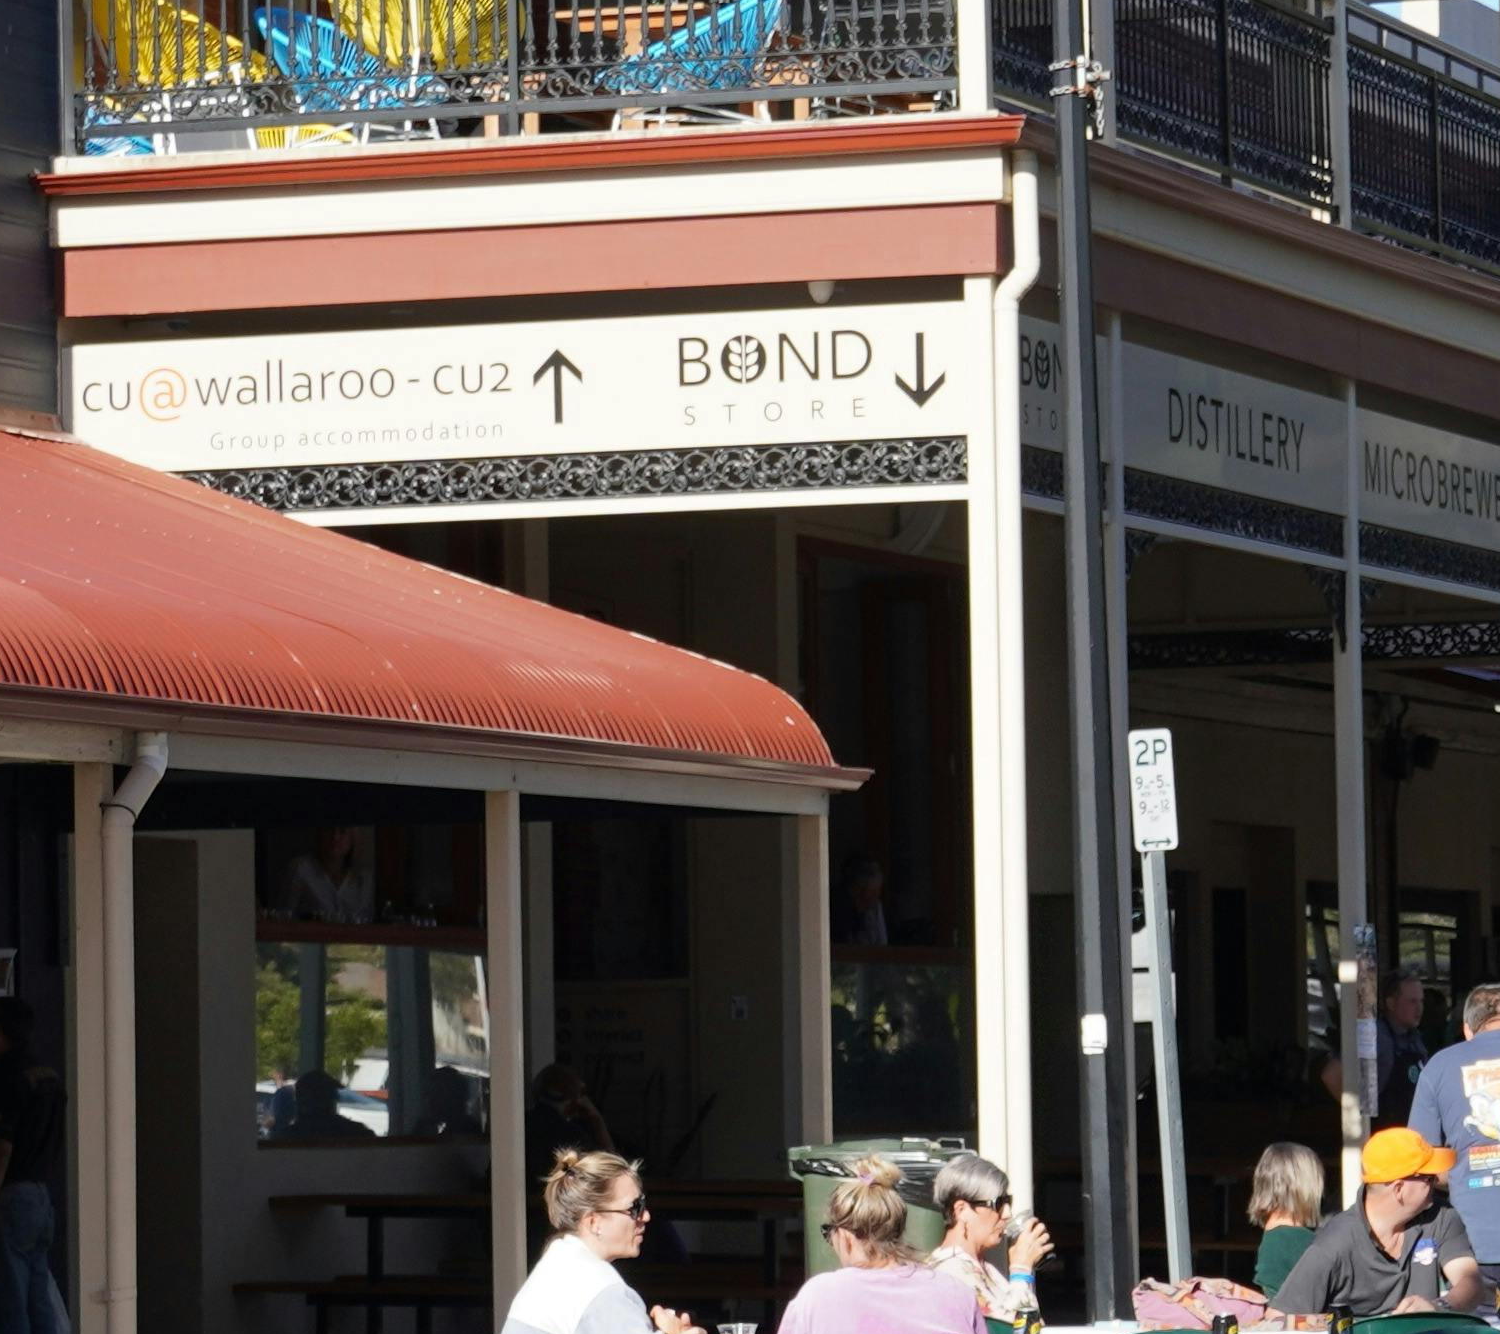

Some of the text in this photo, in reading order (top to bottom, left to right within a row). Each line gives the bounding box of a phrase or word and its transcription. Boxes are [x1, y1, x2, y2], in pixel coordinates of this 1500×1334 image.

[678, 330, 872, 386] BOND
[1020, 335, 1062, 394] BON
[683, 398, 866, 426] STORE
[1024, 403, 1059, 431] STO
[210, 422, 504, 451] Group accommodation
[1168, 387, 1305, 473] DISTILLERY
[1135, 739, 1167, 765] 2P
